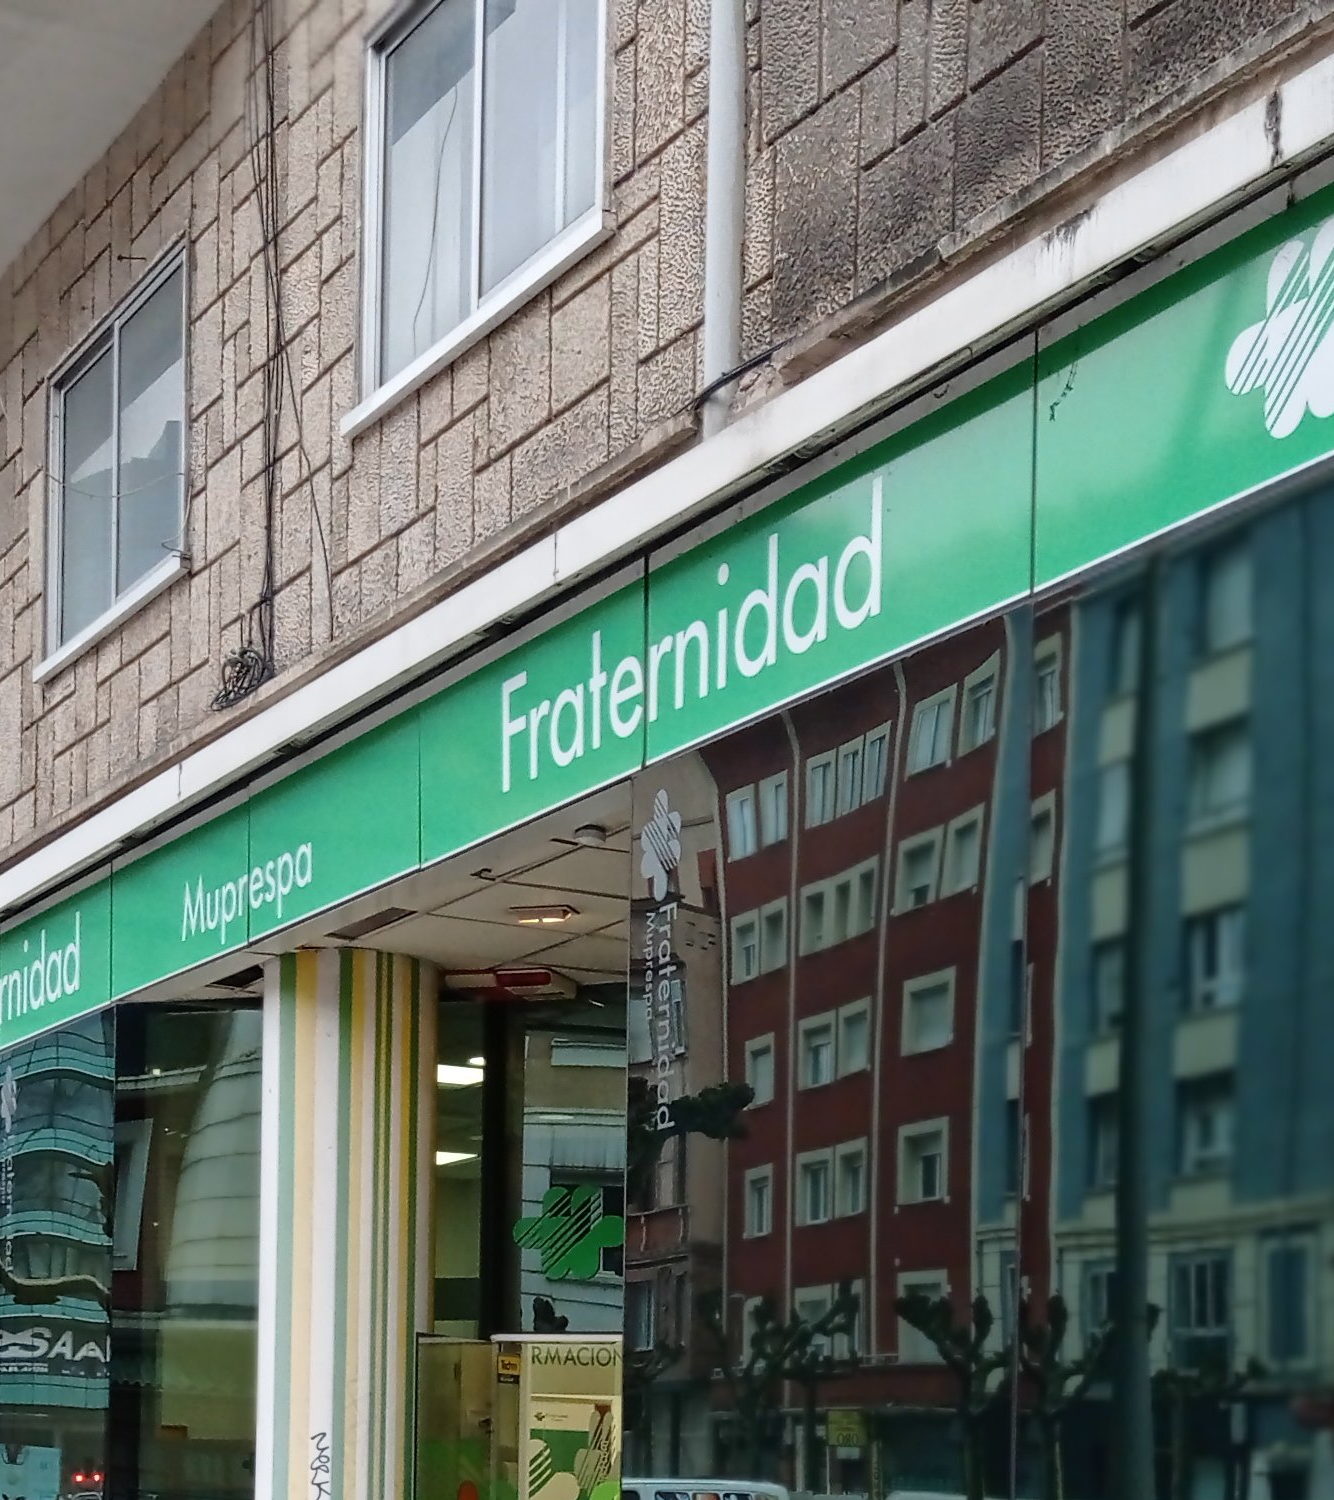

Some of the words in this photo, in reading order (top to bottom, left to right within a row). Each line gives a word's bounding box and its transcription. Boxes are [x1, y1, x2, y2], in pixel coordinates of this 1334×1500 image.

[502, 475, 883, 794] Fraternidad
[180, 841, 313, 946] Muprespa
[655, 901, 678, 1132] Fraternidad
